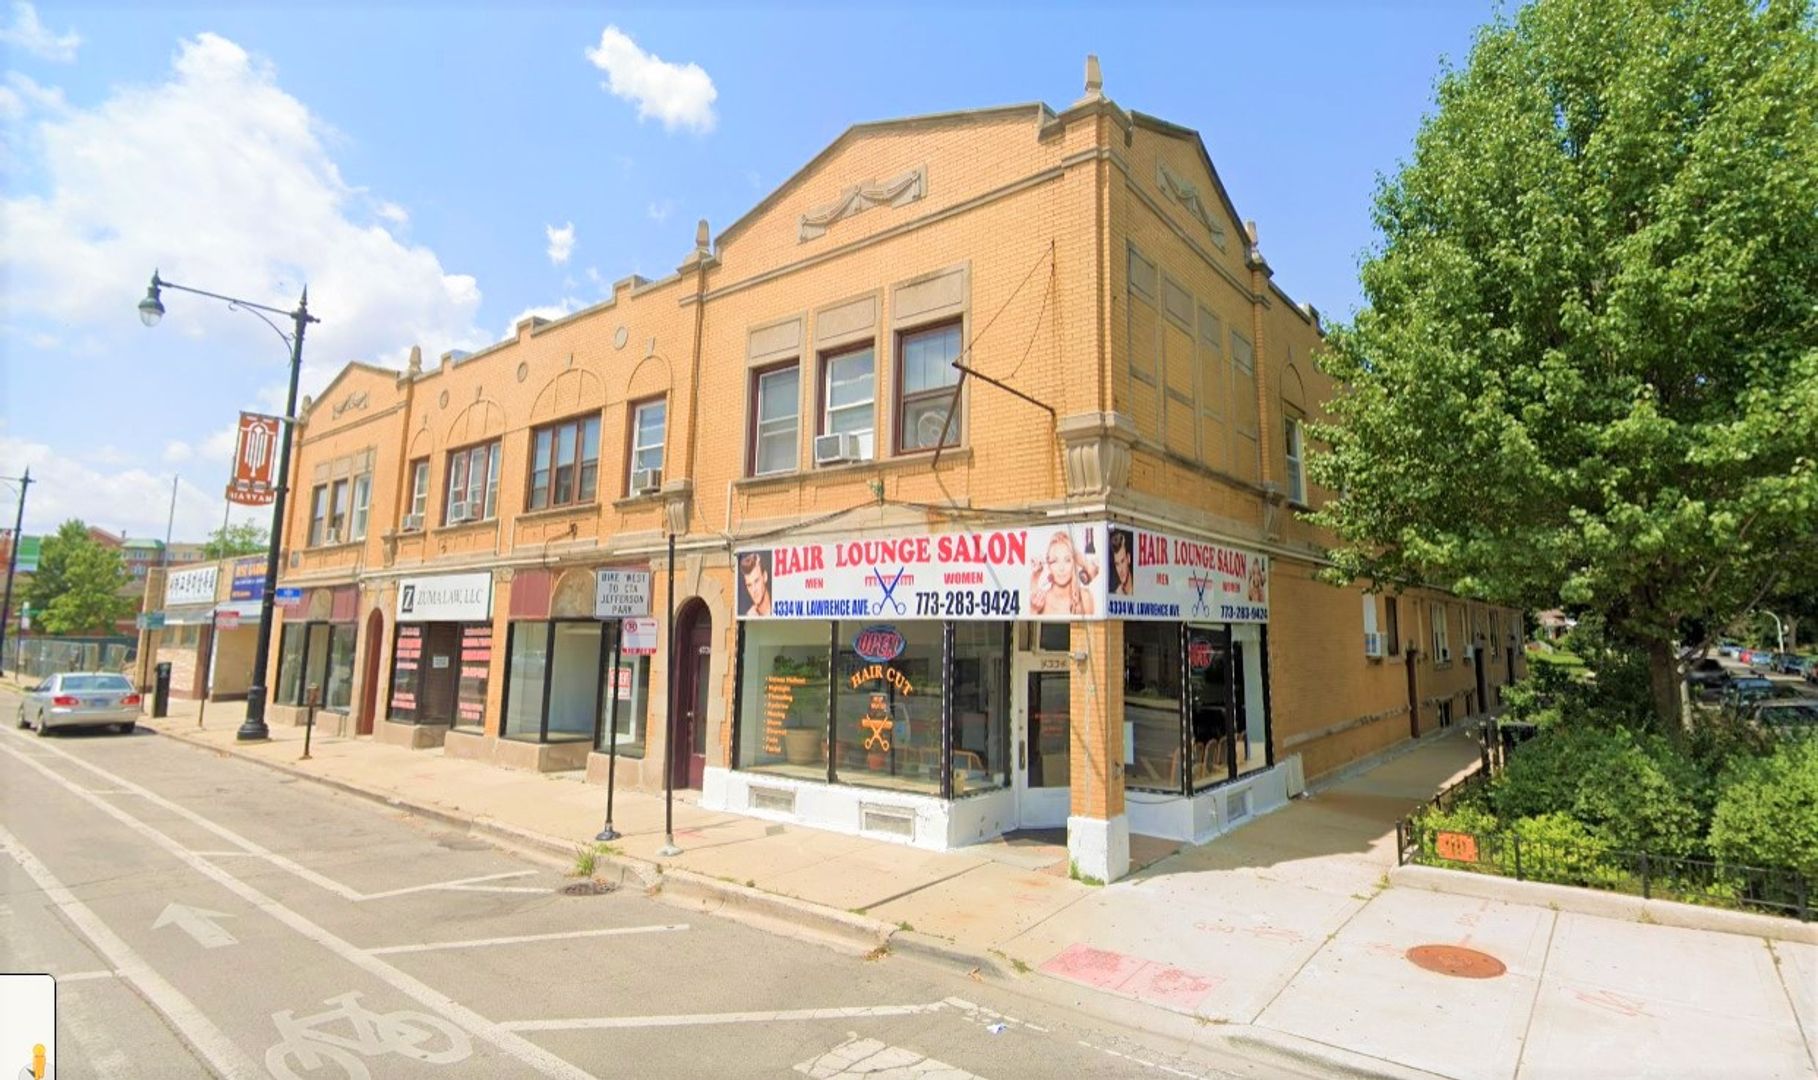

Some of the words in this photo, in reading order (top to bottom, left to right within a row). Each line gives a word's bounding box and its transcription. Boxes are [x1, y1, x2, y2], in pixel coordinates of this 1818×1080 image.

[774, 545, 824, 577] HAIR
[836, 537, 931, 567] LOUNGE
[937, 531, 1029, 566] SALON
[1138, 533, 1168, 567] HAIR
[1174, 540, 1216, 570] LOUNGE
[1217, 547, 1247, 581] SALON
[625, 574, 646, 583] WEST
[805, 578, 823, 589] MEN
[944, 572, 983, 585] WOMEN
[1156, 573, 1168, 586] MEN
[464, 588, 483, 604] LLC
[601, 594, 644, 604] JEFFERSON
[915, 590, 1020, 616] 773-283-9424
[774, 600, 794, 616] 4334
[806, 599, 850, 616] LAWRENCE
[1108, 600, 1127, 615] 4334
[1221, 604, 1268, 619] 773-283-9424
[858, 632, 902, 660] OPEN
[851, 664, 883, 688] HAIR
[886, 667, 913, 696] CUT
